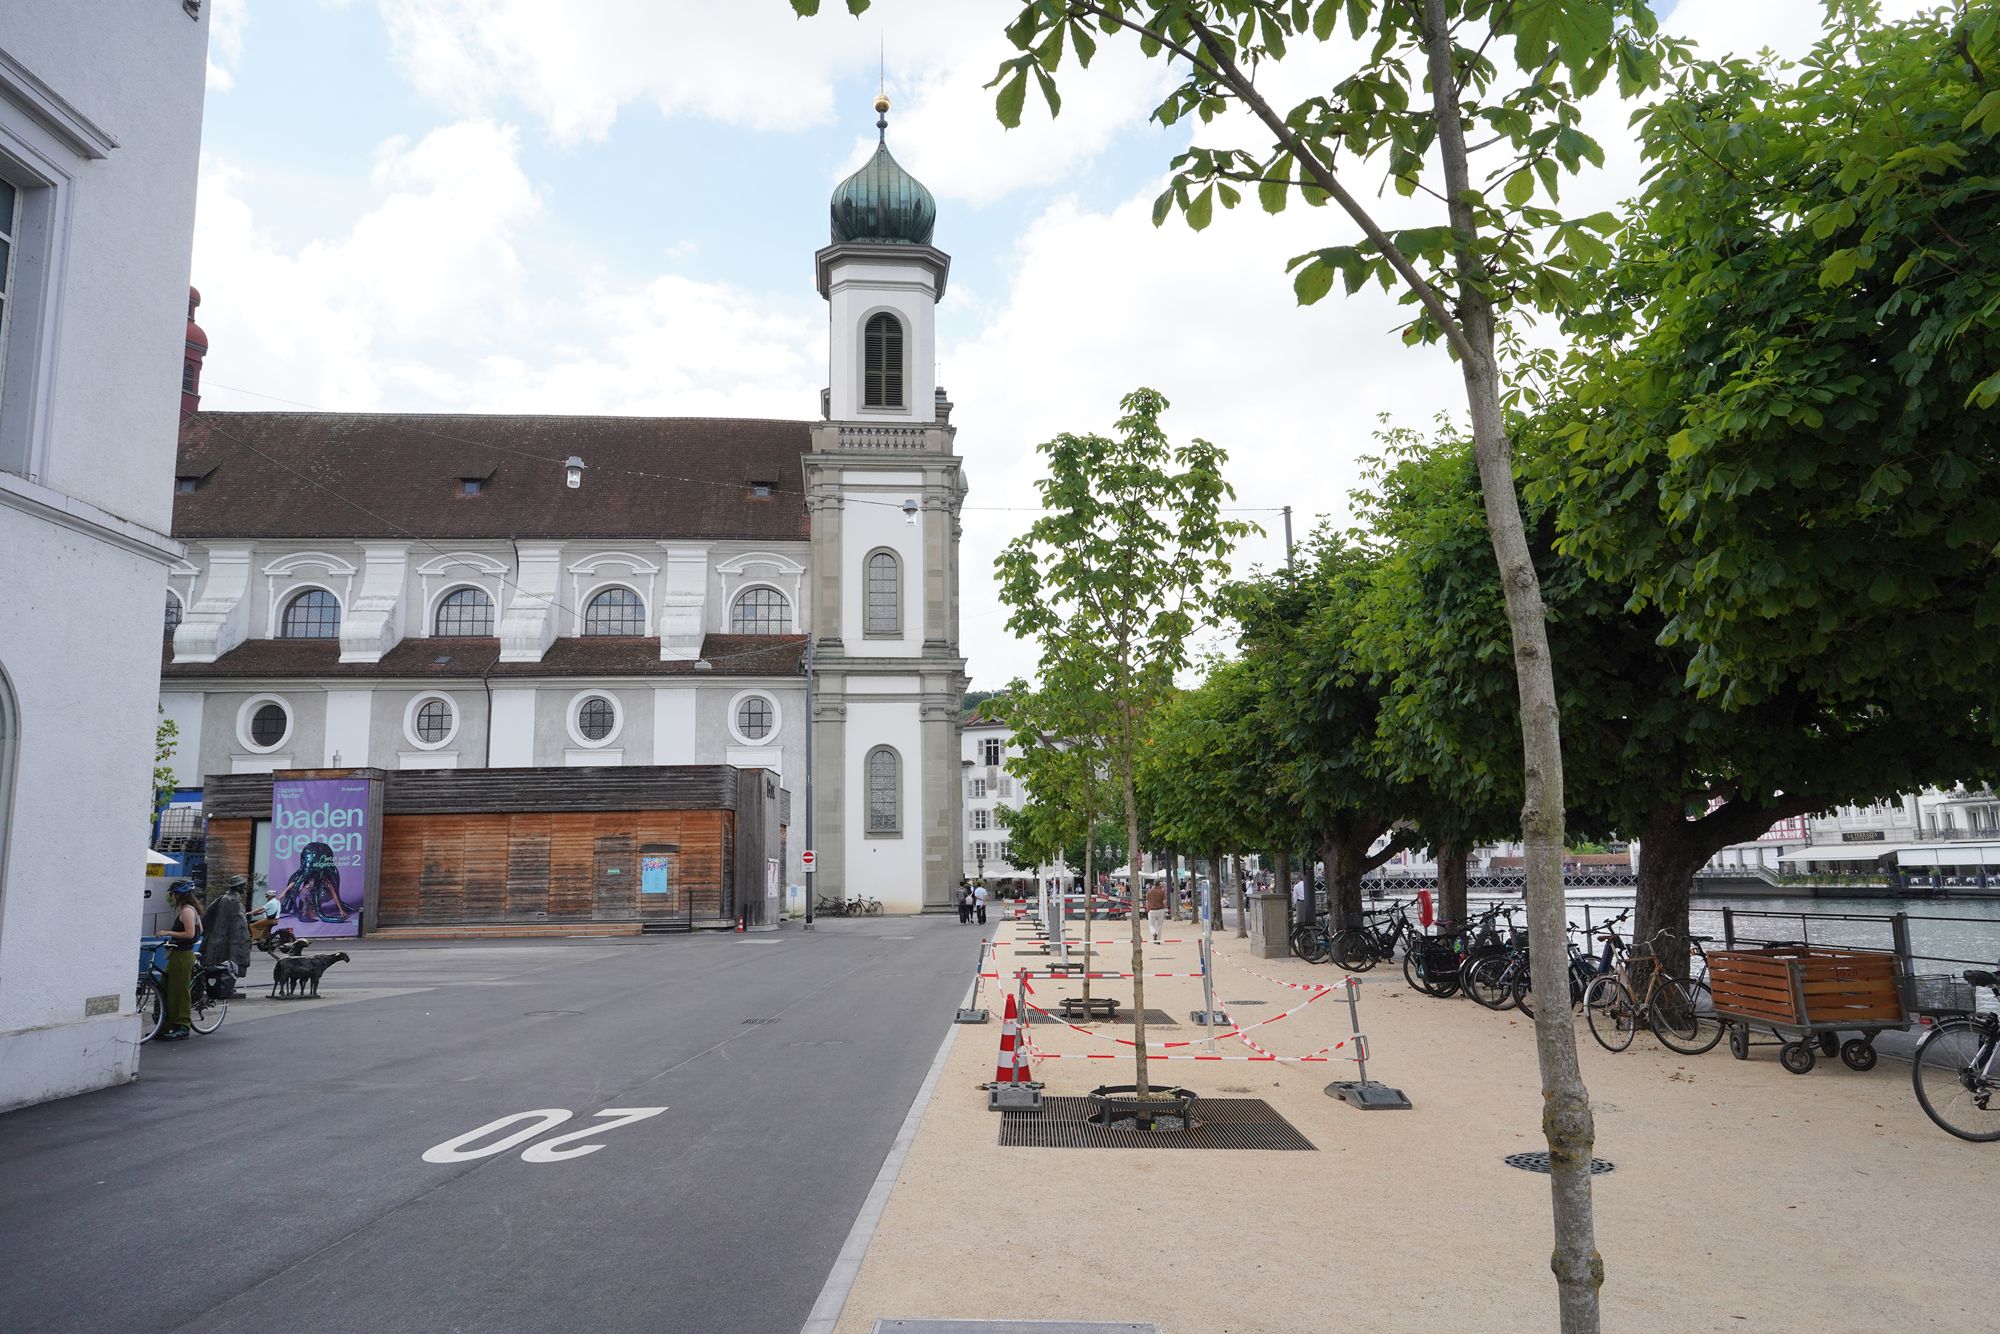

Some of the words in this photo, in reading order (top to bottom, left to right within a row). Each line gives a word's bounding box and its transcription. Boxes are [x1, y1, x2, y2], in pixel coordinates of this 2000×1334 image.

[275, 803, 363, 829] baden
[274, 828, 362, 860] gehen
[351, 854, 361, 866] 2
[421, 1107, 670, 1163] 20
